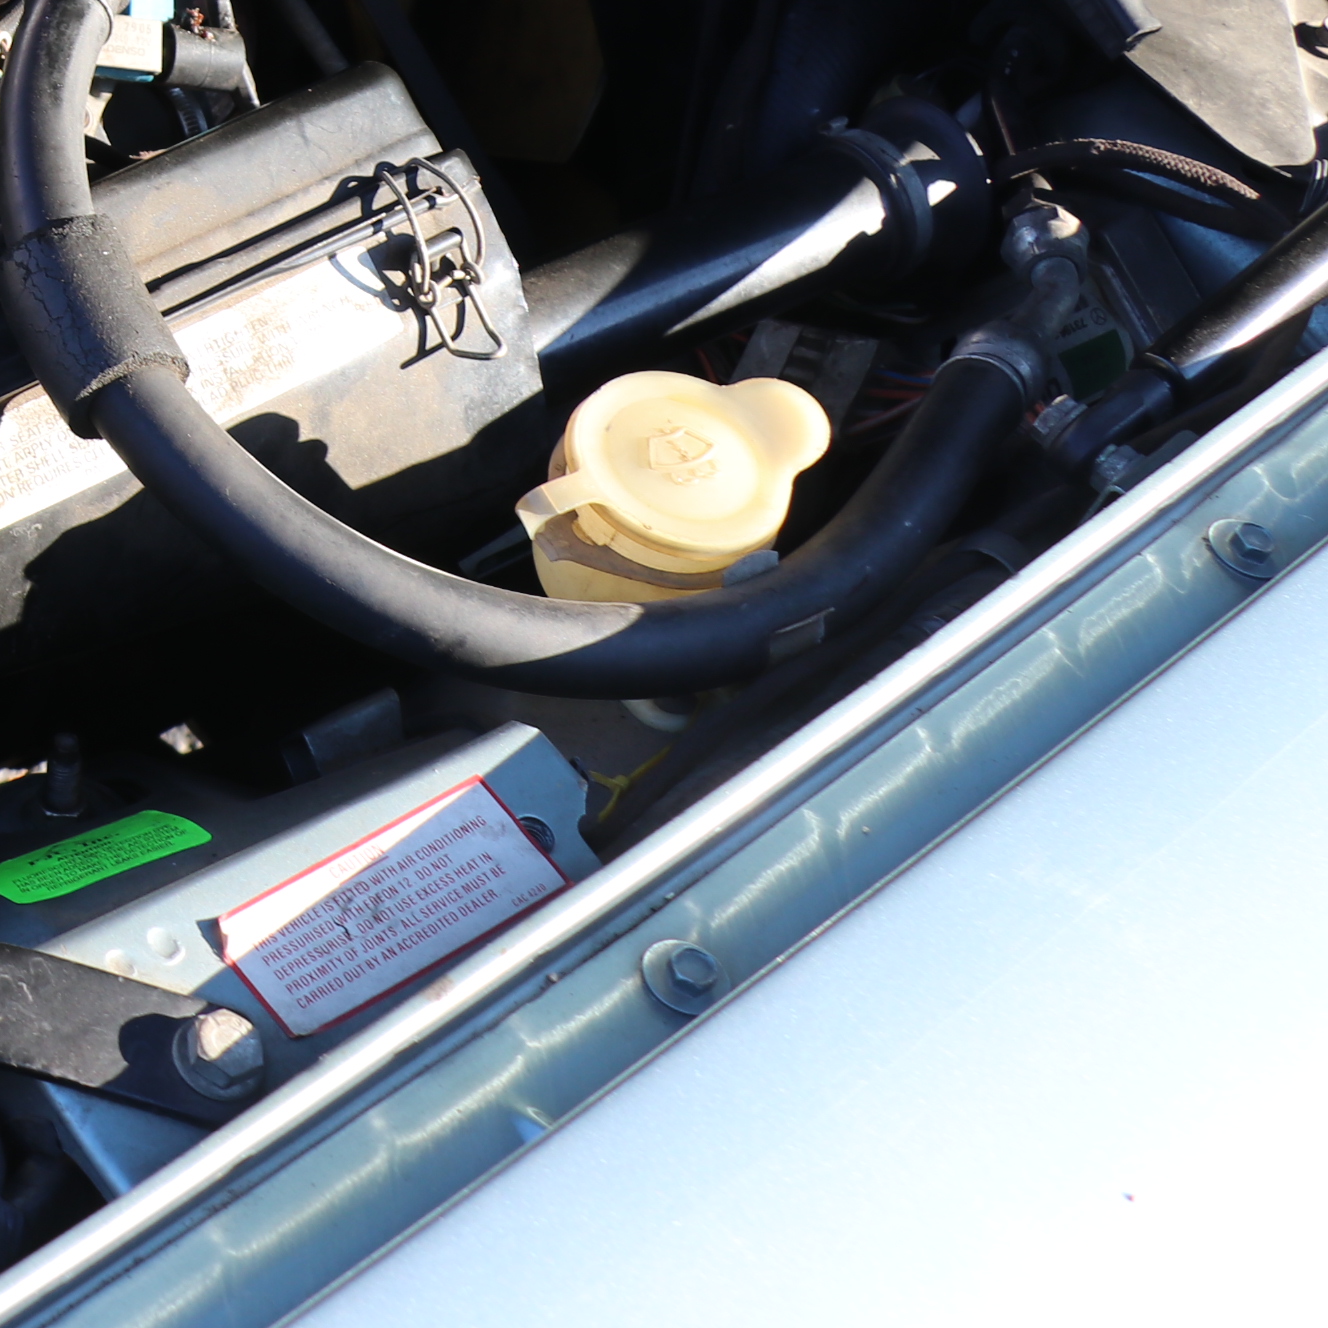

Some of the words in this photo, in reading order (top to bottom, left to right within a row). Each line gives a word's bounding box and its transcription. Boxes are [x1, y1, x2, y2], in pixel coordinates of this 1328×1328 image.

[252, 931, 278, 952] THIS
[277, 907, 322, 937] VEHICLE
[321, 900, 334, 913] IS
[333, 880, 370, 906] FITTED
[368, 865, 397, 886] WITH
[396, 853, 416, 871] AIR
[414, 815, 486, 860] CONDITIONING
[329, 843, 383, 878] CAUTION
[356, 918, 373, 934] DO
[372, 906, 395, 925] NOT
[395, 893, 417, 913] USE
[415, 872, 456, 900] EXCESS
[455, 858, 480, 878] HEAT
[479, 850, 492, 864] IN
[511, 892, 529, 907] CAC
[527, 881, 547, 897] 4240
[262, 921, 335, 965] PRESSURISED
[335, 904, 364, 926] WITH
[364, 885, 399, 909] FREON
[415, 865, 432, 881] DO
[432, 853, 453, 872] NOT
[285, 956, 344, 993] PROXIMITY
[344, 946, 360, 961] OF
[400, 910, 422, 929] ALL
[421, 889, 462, 917] SERVICE
[461, 872, 492, 893] MUST
[490, 863, 505, 878] BE
[297, 977, 343, 1007] CARRIED
[343, 962, 366, 982] OUT
[365, 954, 381, 969] BY
[380, 945, 397, 961] AN
[396, 911, 459, 951] ACCREDITED
